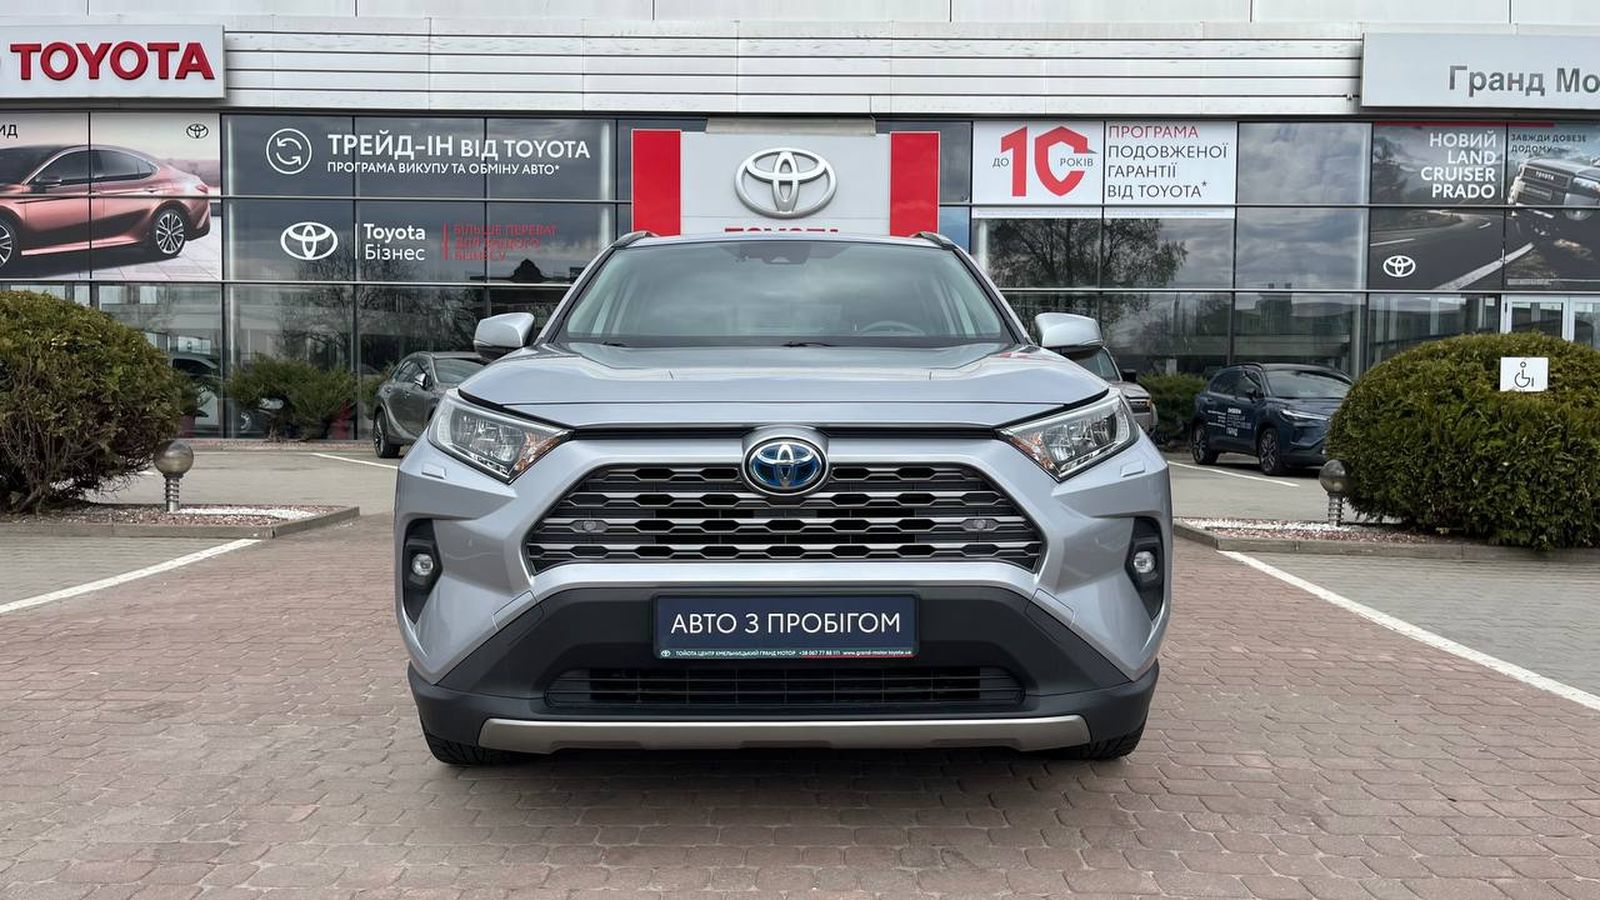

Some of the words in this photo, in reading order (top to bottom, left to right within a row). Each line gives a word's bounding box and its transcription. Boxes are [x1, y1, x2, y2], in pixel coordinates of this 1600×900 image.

[10, 41, 215, 81] TOYOTA
[1449, 65, 1545, 97] Гранд
[1108, 125, 1199, 138] ПРОГРАМА
[1429, 130, 1497, 148] НОВИЙ
[327, 129, 453, 160] ТРЕЙД-ІН
[461, 139, 499, 161] ВІД
[503, 140, 590, 158] TOYOTA
[1108, 142, 1229, 160] ПОДОВЖЕНОЇ
[992, 157, 1010, 168] ДО
[1059, 157, 1094, 168] РОКІВ
[1448, 150, 1496, 165] LAND
[327, 161, 396, 173] ПРОГРАМА
[399, 162, 449, 174] ВИКУПУ
[451, 163, 466, 174] ТА
[468, 163, 519, 175] ОБМІНУ
[1108, 162, 1178, 178] ГАРАНТІЇ
[1421, 166, 1496, 181] CRUISER
[1108, 184, 1133, 200] ВІД
[1432, 183, 1495, 198] PRADO
[363, 223, 426, 243] Toyota
[365, 244, 425, 260] Бізнес
[671, 613, 737, 634] АВТО
[744, 613, 759, 634] З
[767, 613, 900, 634] ПРОБІГОМ
